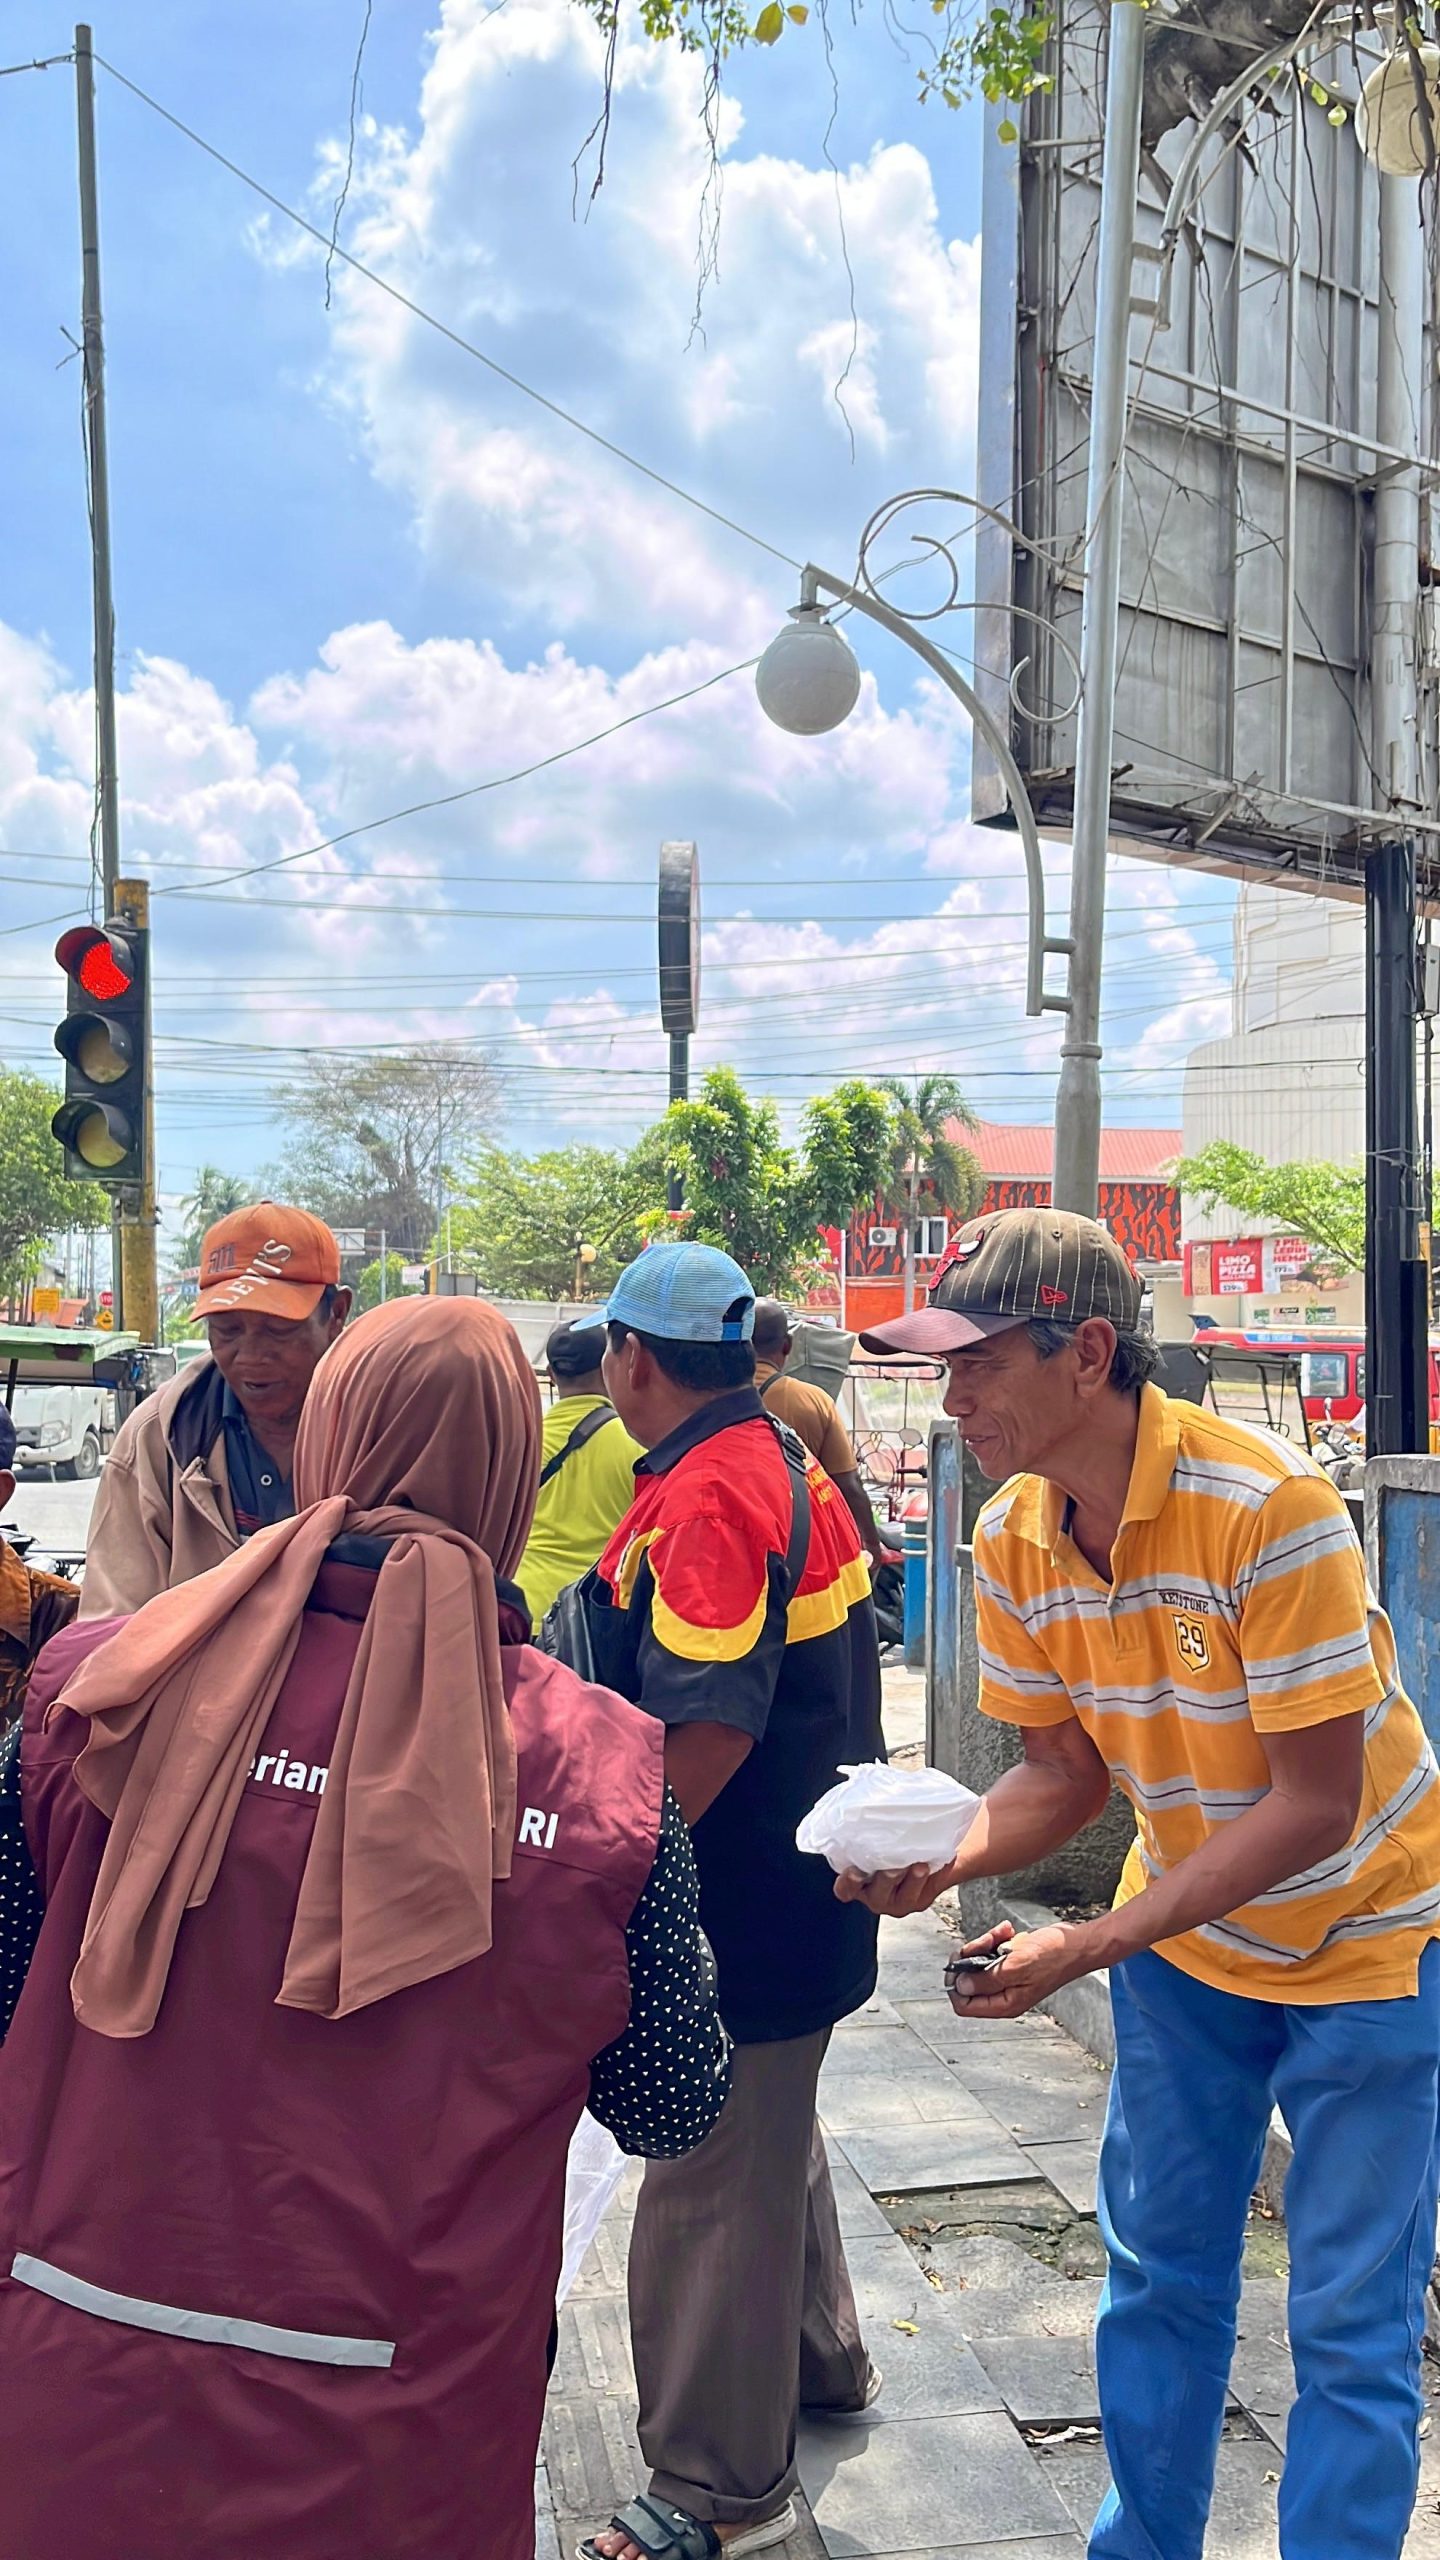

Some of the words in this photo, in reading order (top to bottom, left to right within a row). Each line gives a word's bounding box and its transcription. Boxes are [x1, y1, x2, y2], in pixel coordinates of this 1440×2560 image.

[1219, 1255, 1251, 1266] LIMO
[1219, 1264, 1256, 1275] PIZZA
[1178, 1622, 1205, 1657] 29
[519, 1807, 559, 1849] RI
